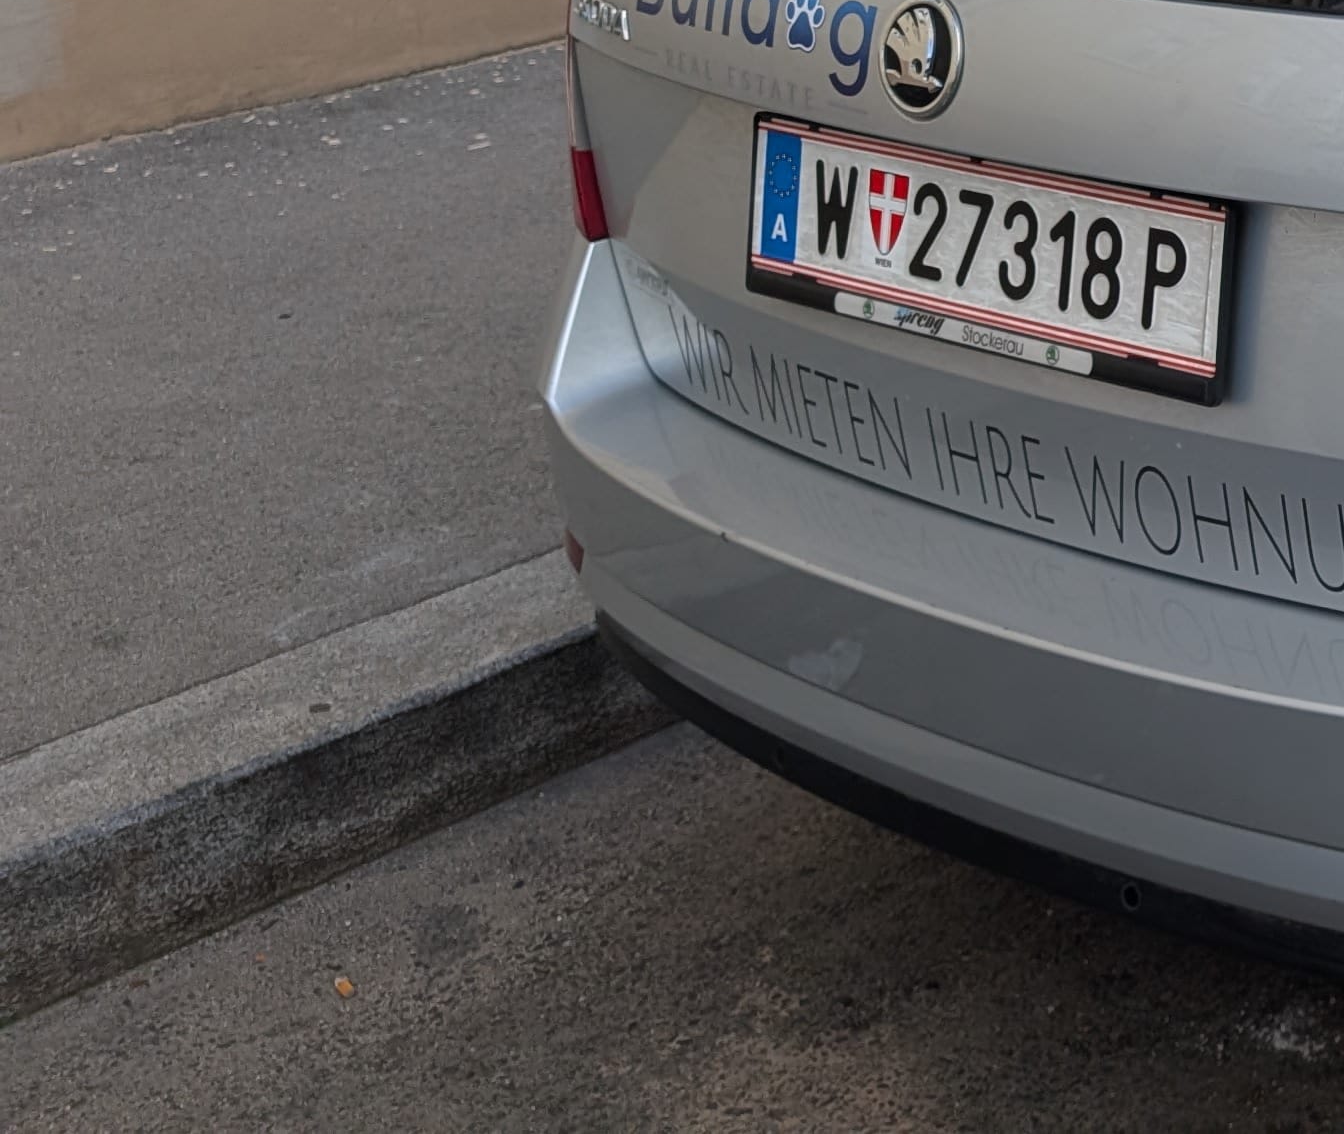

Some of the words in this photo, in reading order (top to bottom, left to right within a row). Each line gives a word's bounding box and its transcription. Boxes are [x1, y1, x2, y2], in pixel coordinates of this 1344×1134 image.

[727, 64, 816, 108] ESTATE
[771, 213, 788, 243] A
[816, 159, 859, 259] W
[909, 183, 1124, 321] 27318
[1141, 227, 1188, 331] P
[962, 324, 1024, 356] Stockerau
[669, 312, 748, 415] WIR
[748, 344, 912, 479] MIETEN
[927, 409, 1055, 526] IHRE
